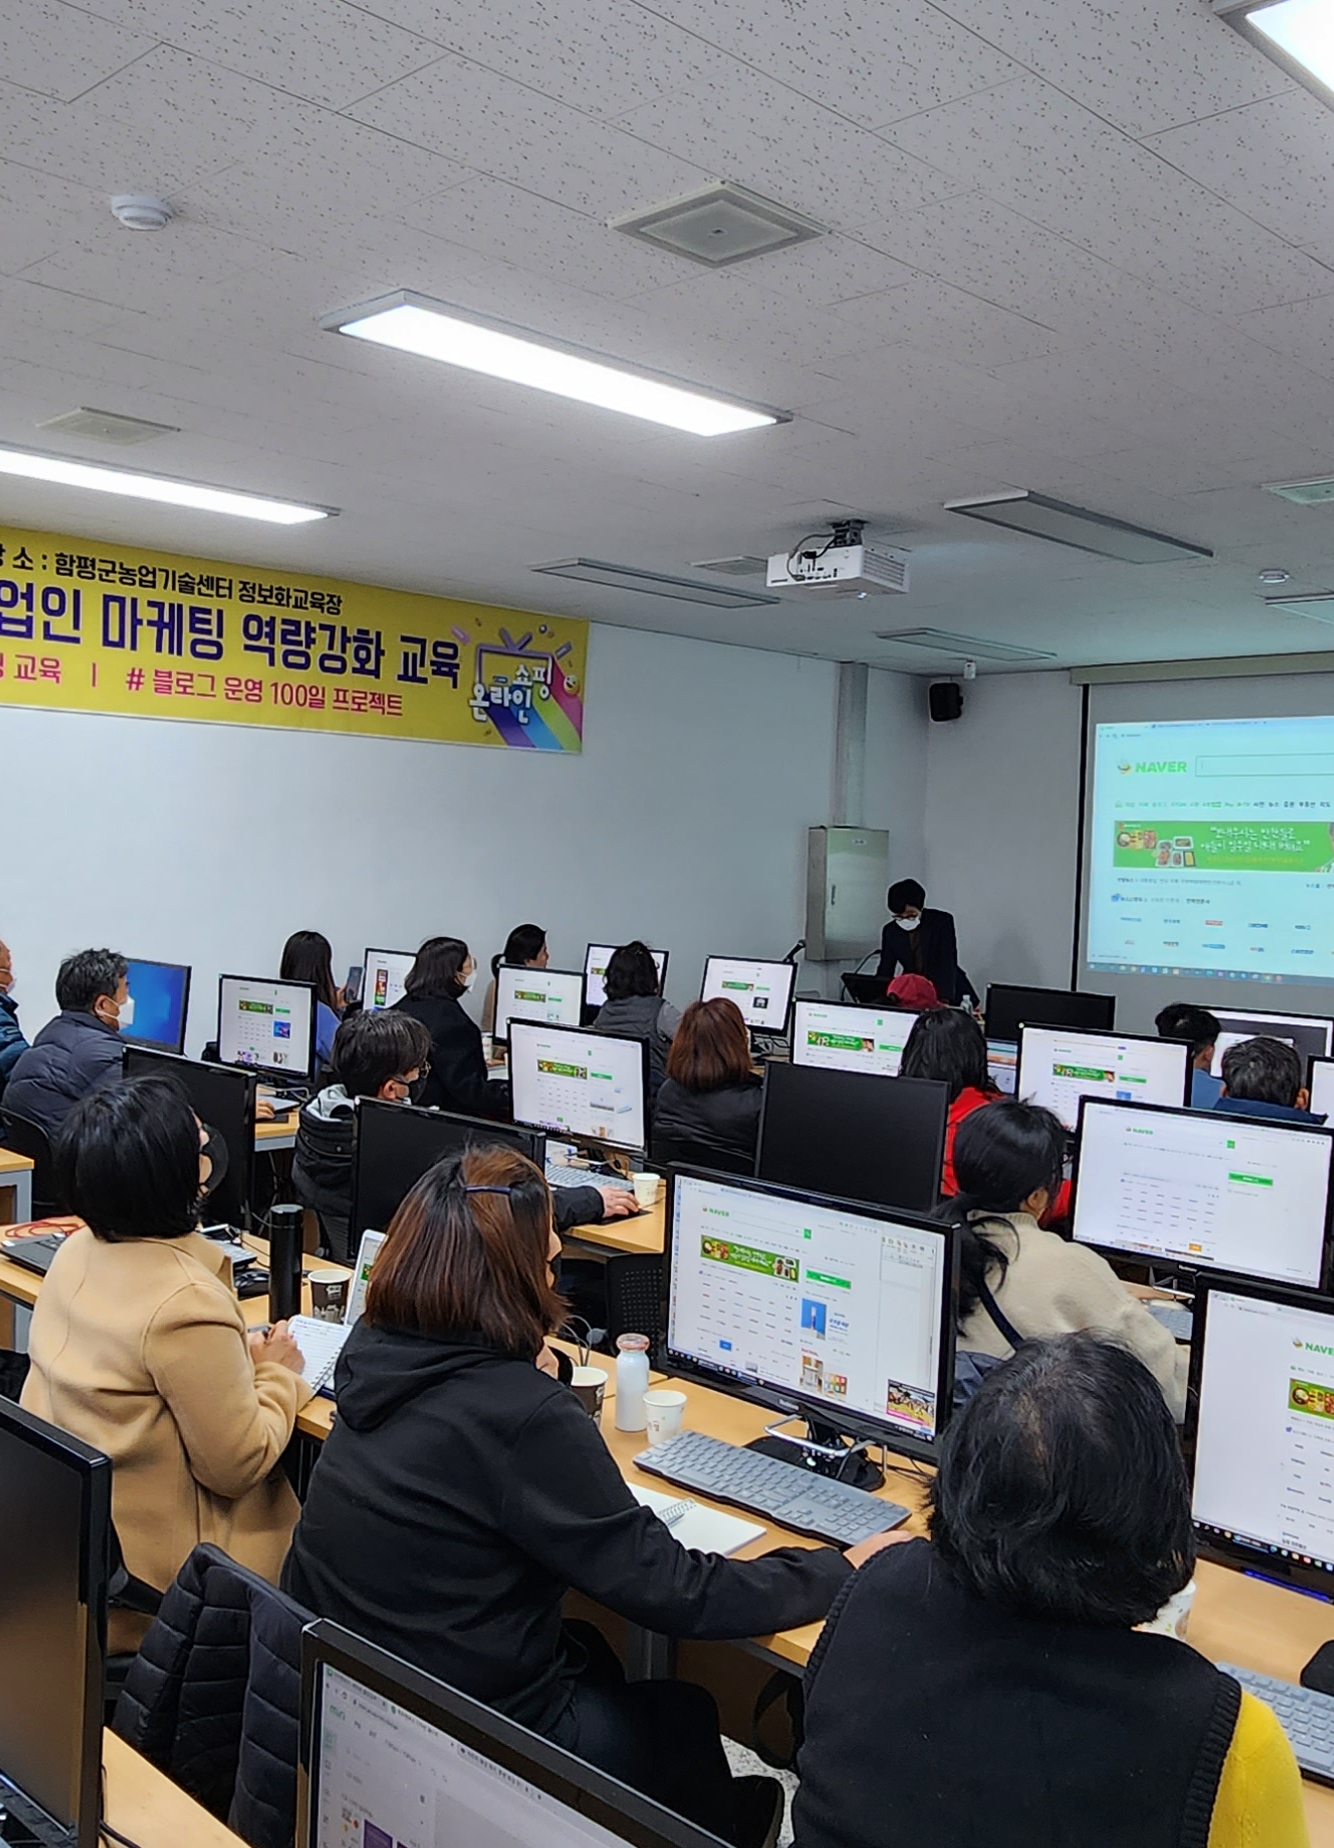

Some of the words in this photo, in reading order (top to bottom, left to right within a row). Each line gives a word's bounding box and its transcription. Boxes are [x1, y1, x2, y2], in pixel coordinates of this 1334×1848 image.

[12, 544, 34, 571] 소
[55, 552, 233, 601] 함평군농업기술센터
[238, 580, 342, 616] 정보화교육장
[101, 595, 224, 660] 마케팅
[242, 615, 385, 680] 역량강화
[397, 633, 460, 690] 교육
[13, 653, 62, 684] 교육
[126, 668, 145, 692] #
[152, 669, 217, 698] 블로그
[223, 677, 264, 704] 운영
[270, 680, 326, 711] 100일
[332, 684, 403, 717] 프로젝트
[469, 683, 531, 724] 온라인
[512, 664, 551, 699] 쇼핑
[1135, 761, 1187, 773] NAVER
